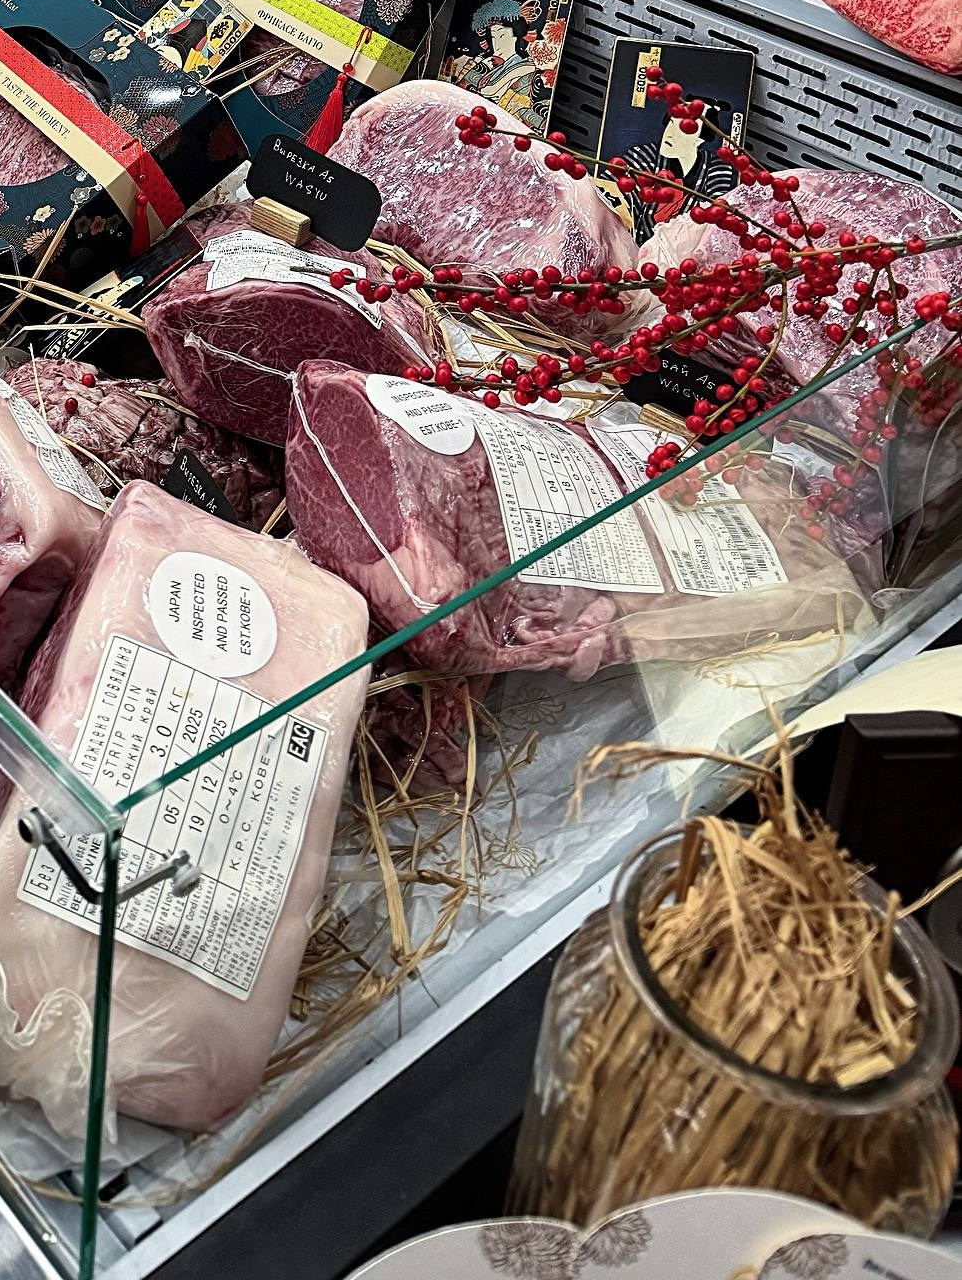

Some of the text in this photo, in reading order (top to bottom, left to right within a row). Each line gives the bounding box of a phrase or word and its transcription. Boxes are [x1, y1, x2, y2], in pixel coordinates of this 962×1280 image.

[257, 8, 325, 52] ФРИКАСЕ ВАГЮ
[1, 76, 26, 100] TASTE
[22, 93, 41, 112] THE
[391, 389, 435, 403] INSPECTED
[405, 402, 453, 418] AND PASSED
[524, 510, 533, 524] Beef
[168, 580, 182, 623] JAPAN
[191, 573, 205, 642] INSPECTED
[216, 575, 228, 653] AND PASSED
[240, 586, 252, 656] EST.KOBE-1
[101, 684, 142, 779] STRIP LOIN
[115, 686, 159, 791] Тонкий край
[27, 645, 132, 893] Без говядина
[163, 706, 204, 826] 05 2025
[189, 775, 219, 834] 19 12
[251, 863, 269, 892] JAPAN
[149, 890, 178, 942] Expiration
[159, 923, 176, 948] Срок
[170, 922, 191, 954] Storage
[198, 908, 223, 953] Producer
[201, 890, 240, 970] Производитель
